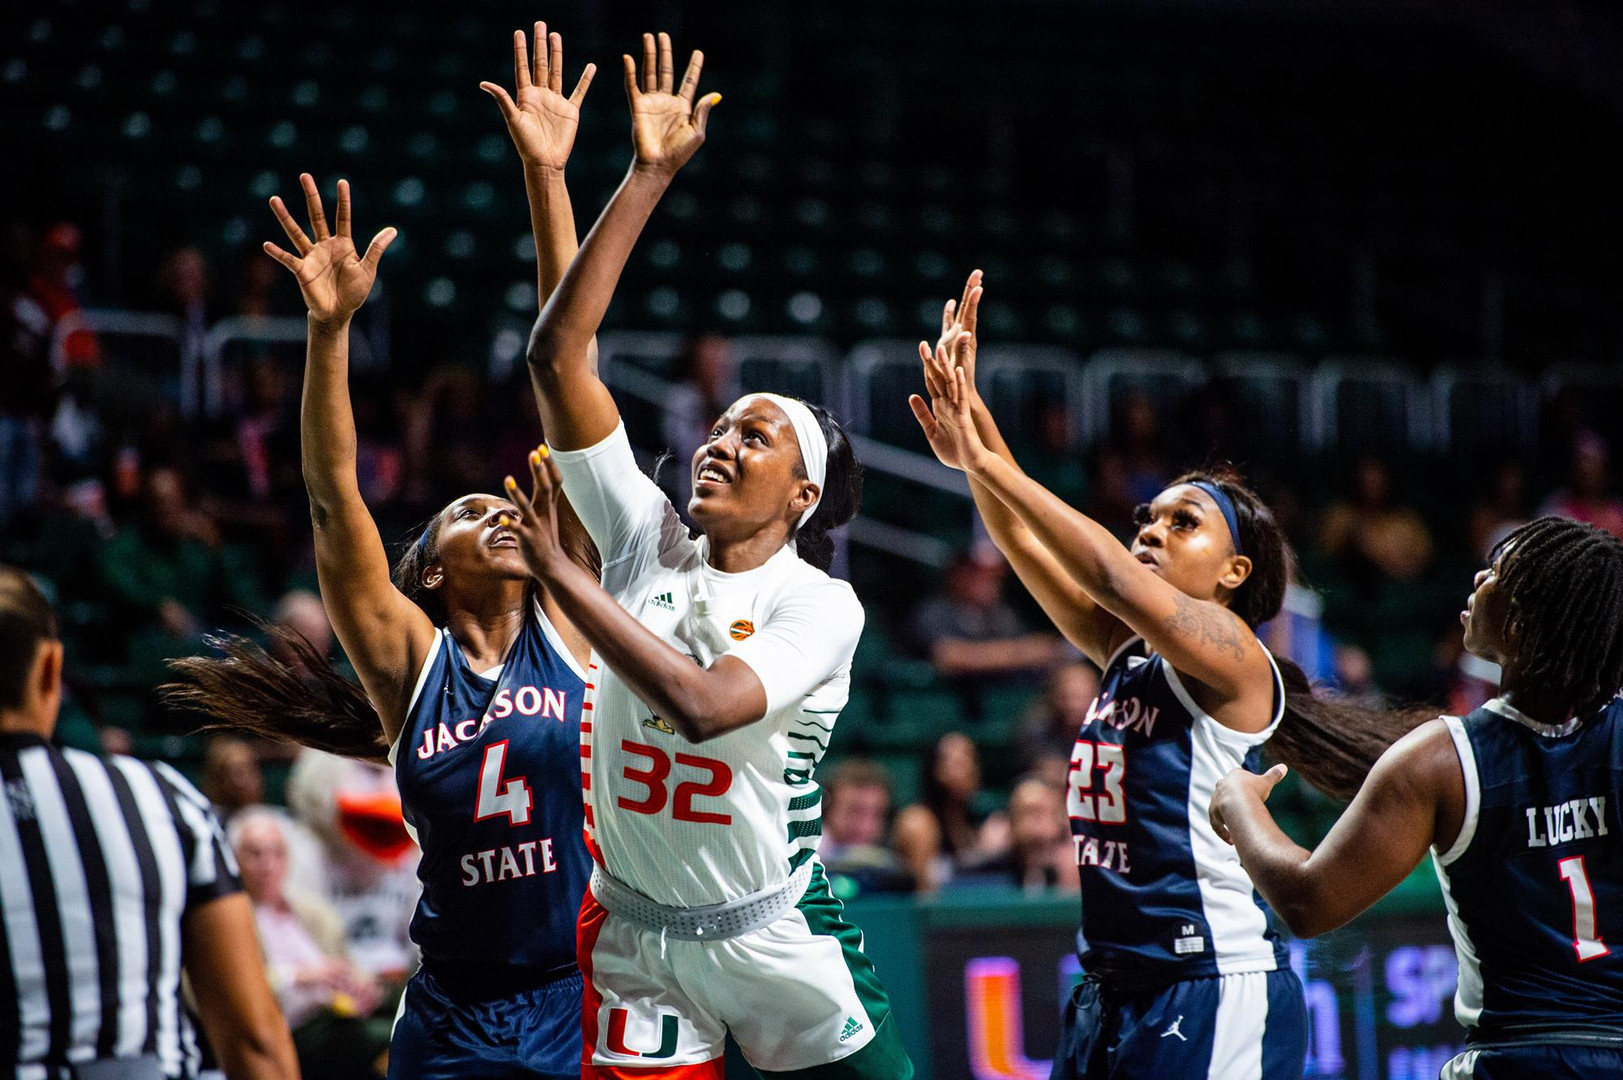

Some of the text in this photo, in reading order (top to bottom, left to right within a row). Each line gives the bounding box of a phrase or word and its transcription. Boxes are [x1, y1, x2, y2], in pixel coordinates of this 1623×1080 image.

[474, 739, 534, 827] 4
[617, 738, 733, 826] 32
[1066, 739, 1127, 825] 23
[1525, 796, 1608, 847] LUCKY
[460, 838, 557, 887] STATE
[1072, 833, 1132, 874] TATE
[1181, 924, 1195, 936] M
[1557, 854, 1611, 964] 1
[606, 1007, 679, 1058] U
[839, 1023, 864, 1042] adidas
